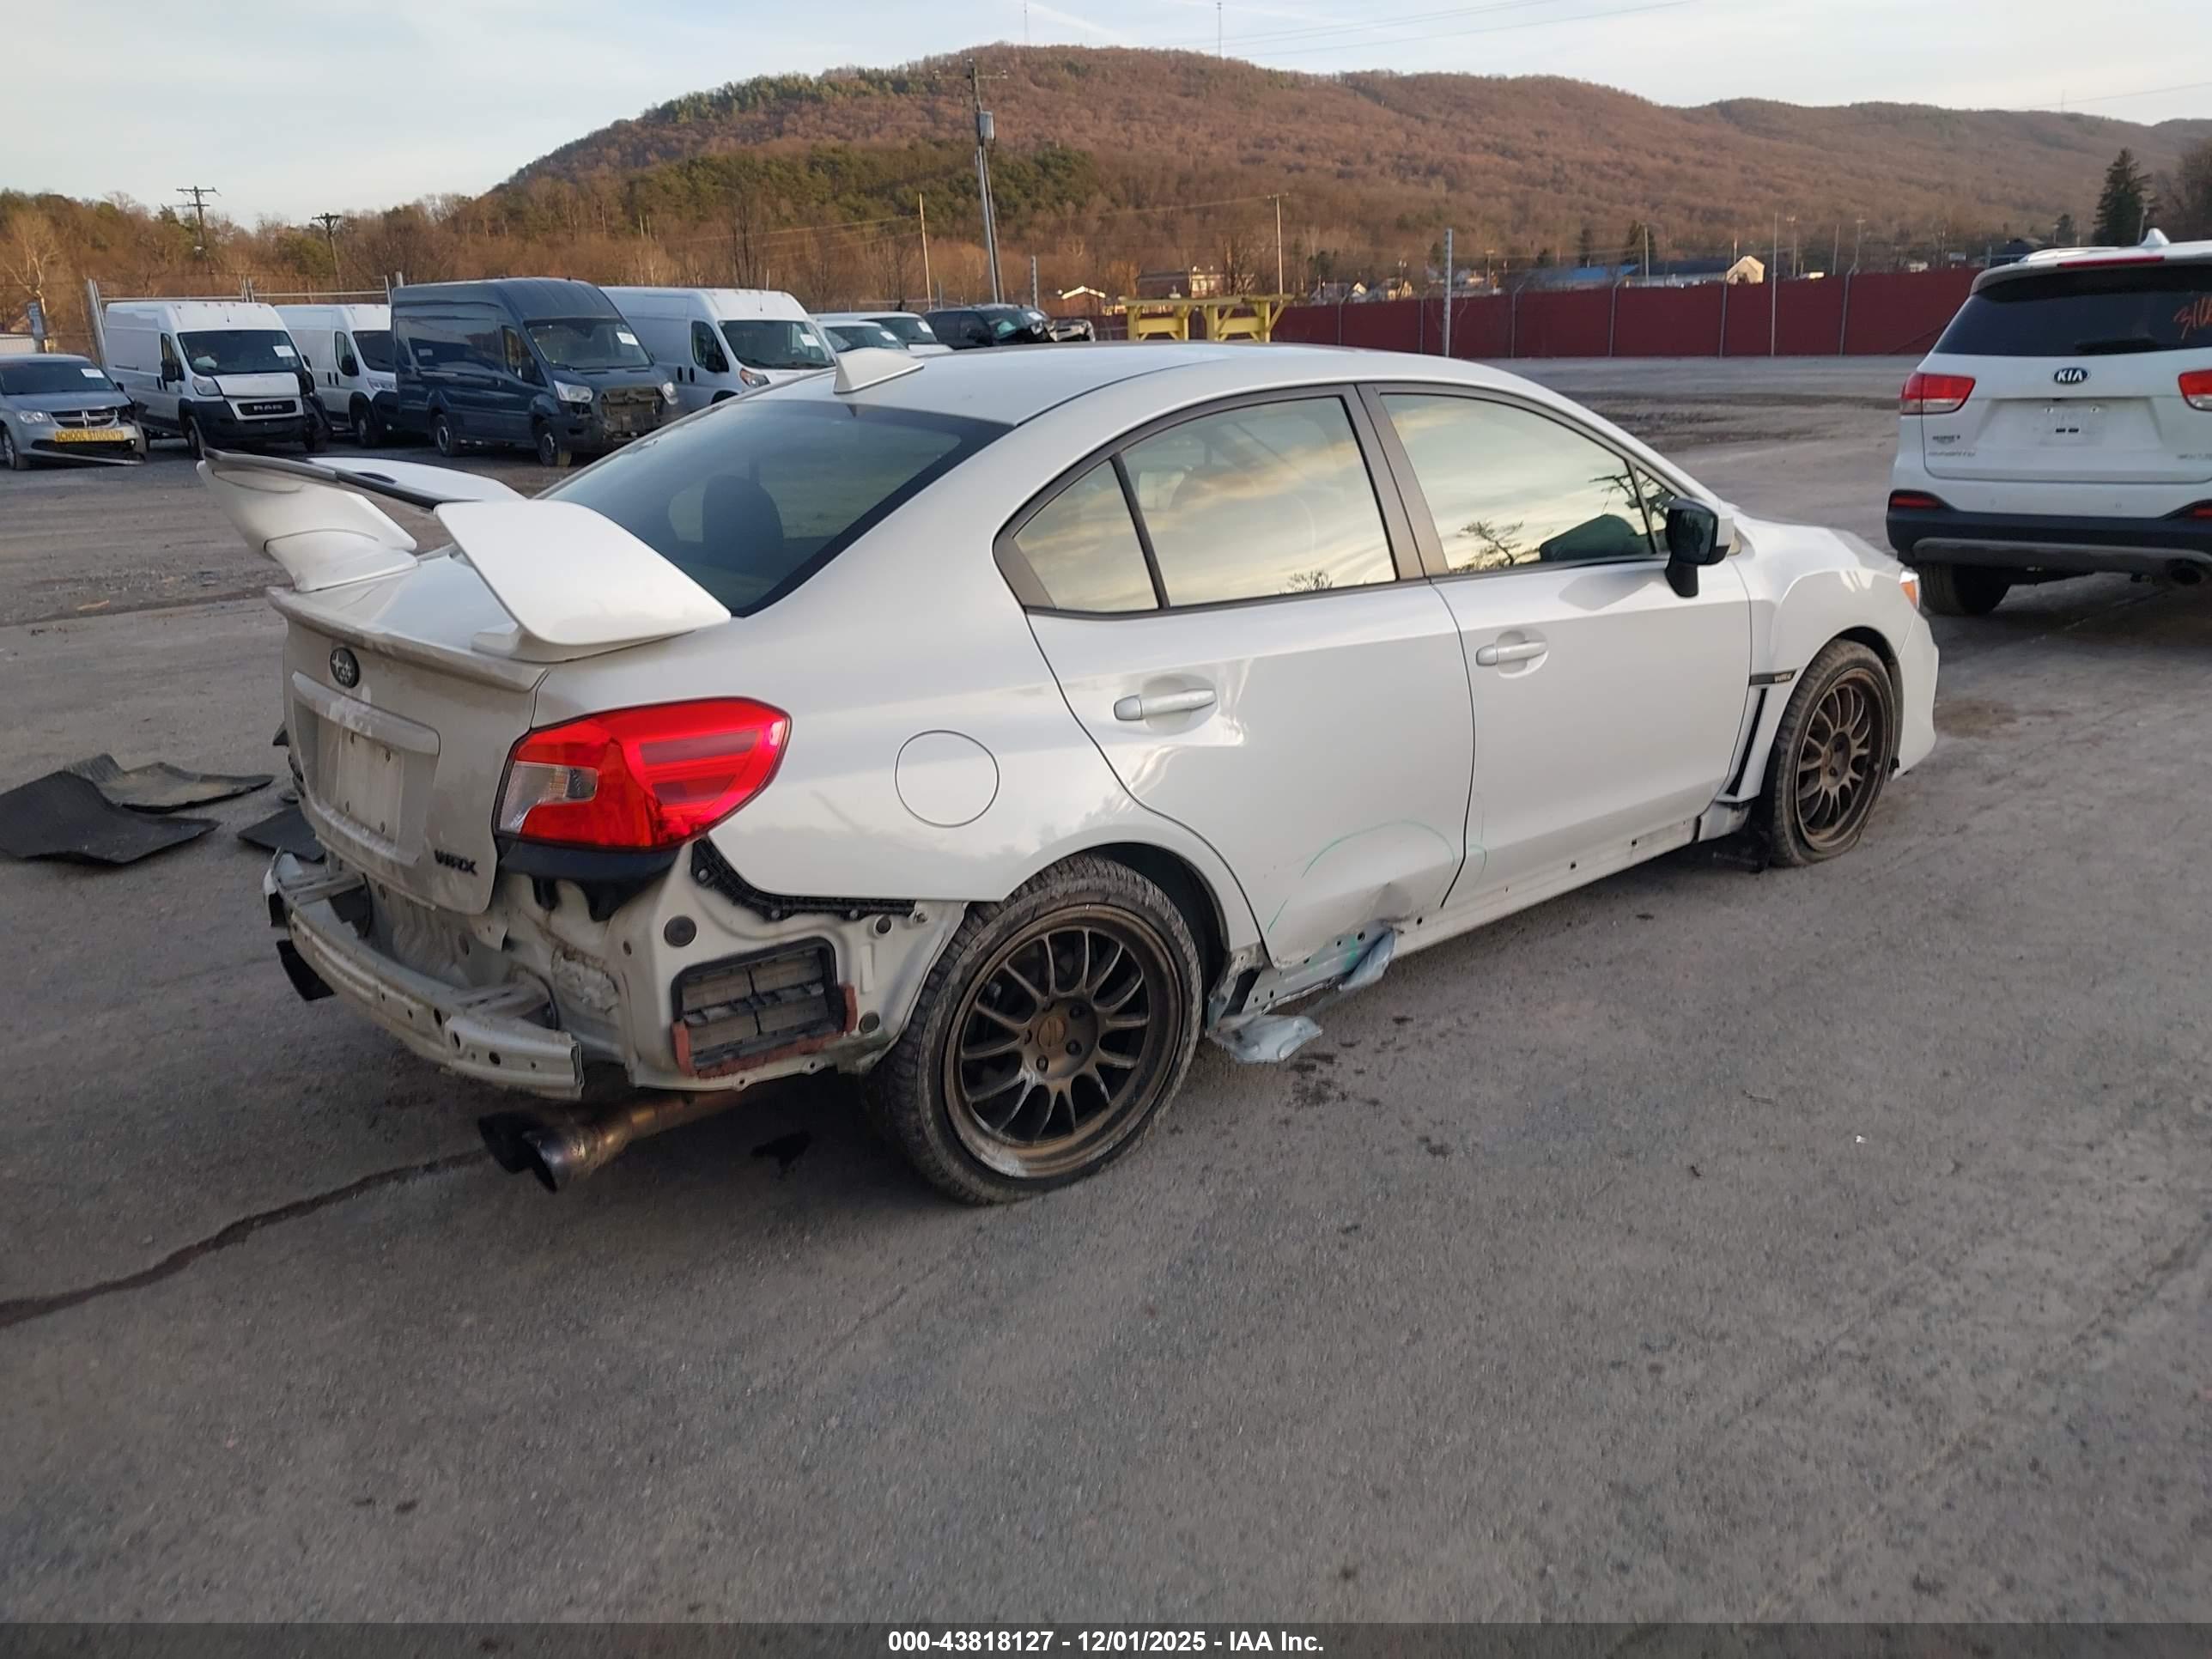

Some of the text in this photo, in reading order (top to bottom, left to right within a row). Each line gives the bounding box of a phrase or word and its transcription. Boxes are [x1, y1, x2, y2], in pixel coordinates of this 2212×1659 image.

[2057, 369, 2082, 383] KIA
[253, 404, 283, 413] RAM
[55, 430, 124, 441] SCHOOL STUDENTS
[434, 848, 477, 877] WRX
